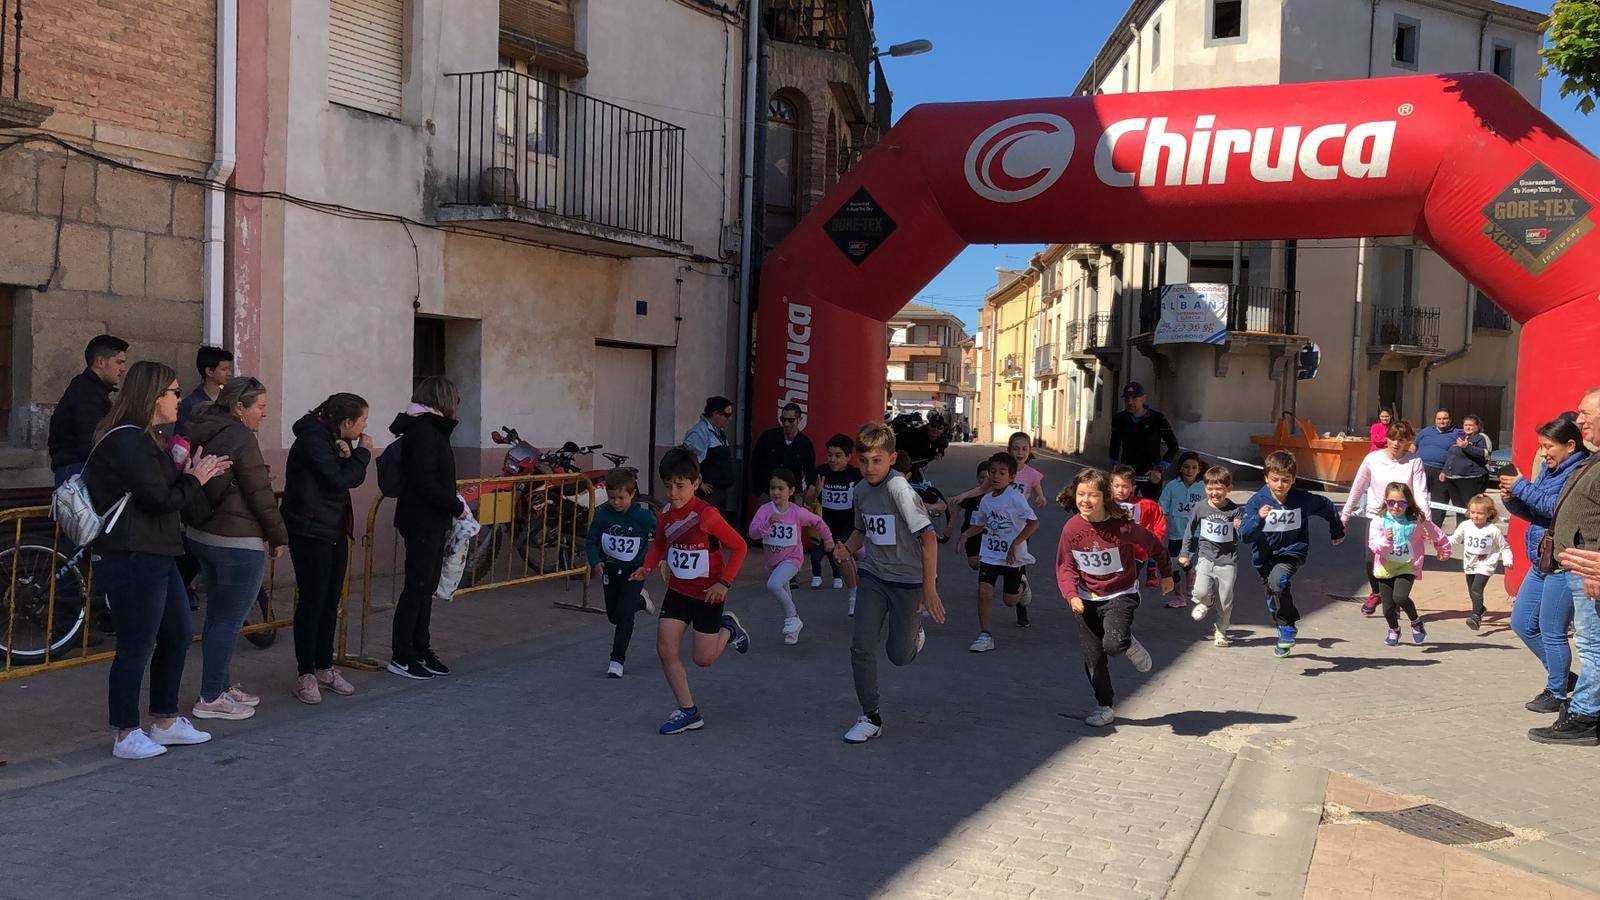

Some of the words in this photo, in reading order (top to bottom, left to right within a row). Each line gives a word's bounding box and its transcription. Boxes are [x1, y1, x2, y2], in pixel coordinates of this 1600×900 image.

[1094, 115, 1397, 188] Chiruca
[1495, 200, 1576, 220] GORE-TEX
[826, 492, 848, 504] 323
[1268, 510, 1295, 525] 342
[769, 525, 793, 540] 333
[864, 517, 887, 535] 48
[1206, 522, 1229, 537] 340
[608, 537, 635, 554] 332
[987, 538, 1008, 553] 329
[1467, 536, 1487, 549] 335
[672, 550, 700, 569] 327
[1080, 552, 1112, 568] 339
